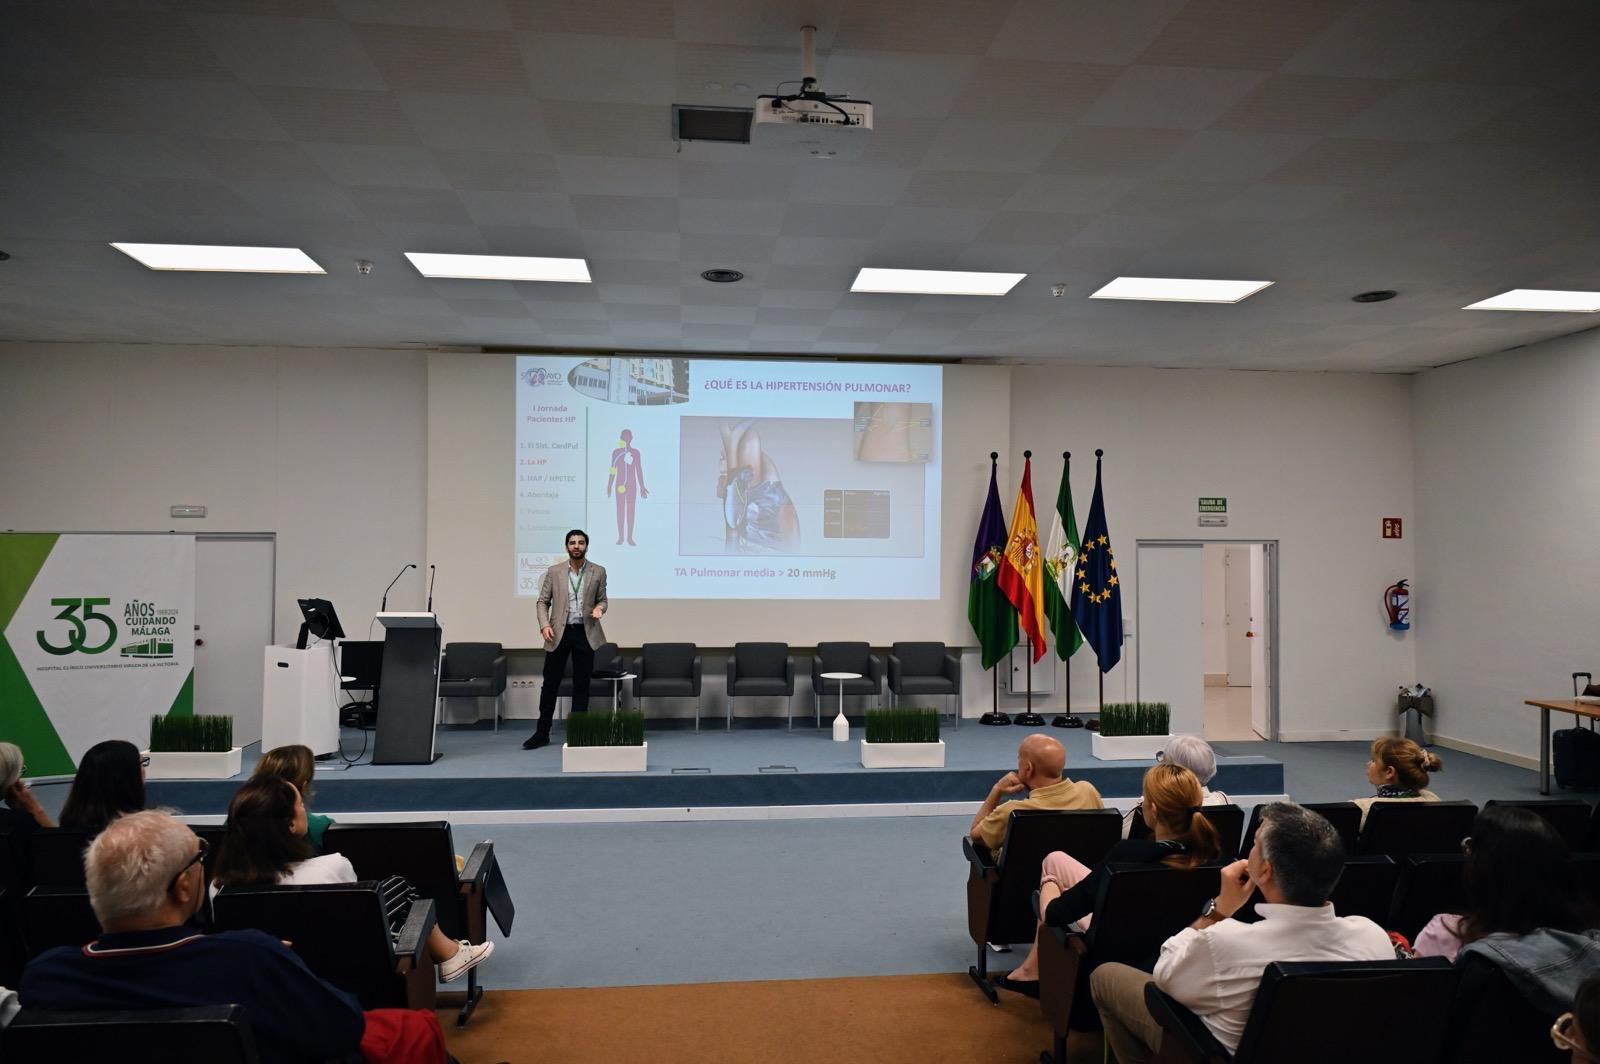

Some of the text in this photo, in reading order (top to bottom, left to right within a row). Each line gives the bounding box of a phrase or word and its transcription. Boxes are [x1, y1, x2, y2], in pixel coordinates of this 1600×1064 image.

[704, 378, 912, 393] ¿QUÉ ES LA HIPERTENSIÓN PULMONAR?
[537, 404, 568, 412] Jornada
[527, 415, 563, 423] Pacientes
[674, 567, 837, 580] TA Pulmonar media > 20 mmHg
[36, 597, 118, 656] 35
[123, 599, 155, 617] AÑOS
[125, 616, 176, 626] CUIDANDO
[131, 625, 171, 636] MÁLAGA
